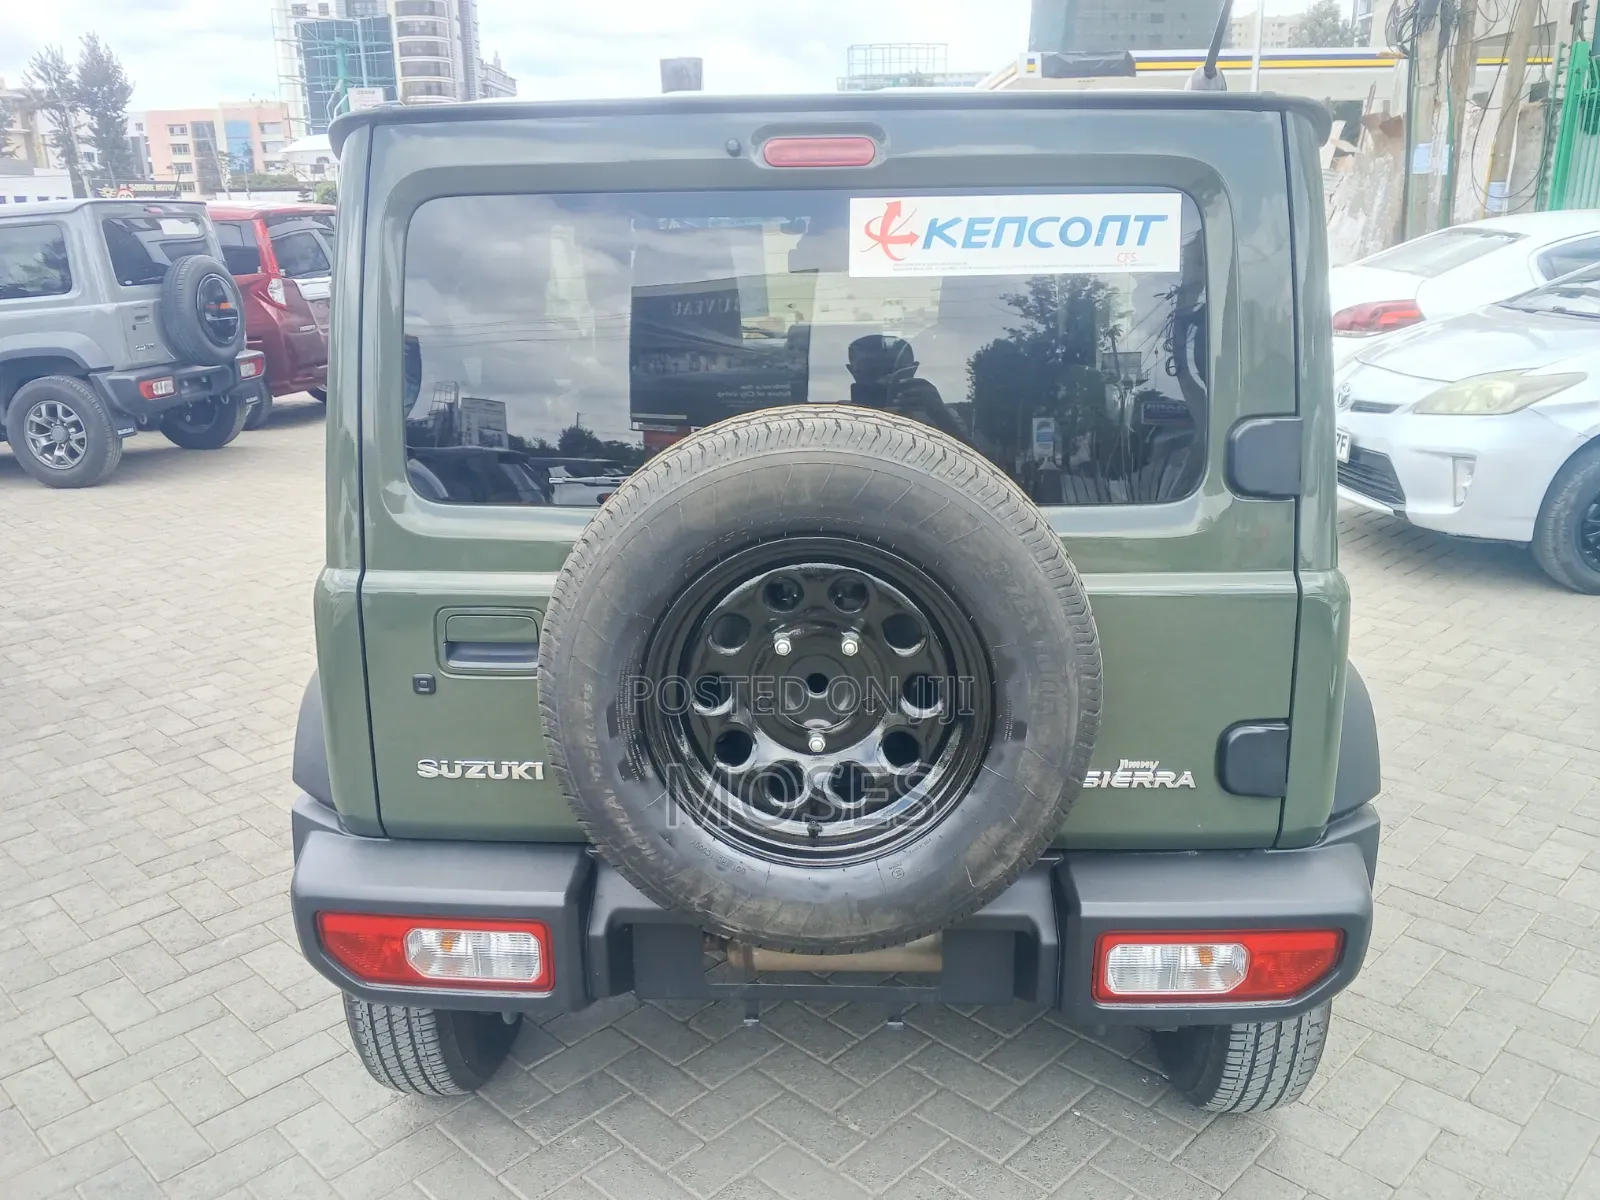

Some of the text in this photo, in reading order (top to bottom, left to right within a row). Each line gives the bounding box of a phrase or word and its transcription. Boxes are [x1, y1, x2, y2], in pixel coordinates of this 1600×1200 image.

[1116, 252, 1138, 263] CFS
[417, 759, 544, 780] SUZUKI
[1082, 770, 1196, 788] SIERRA
